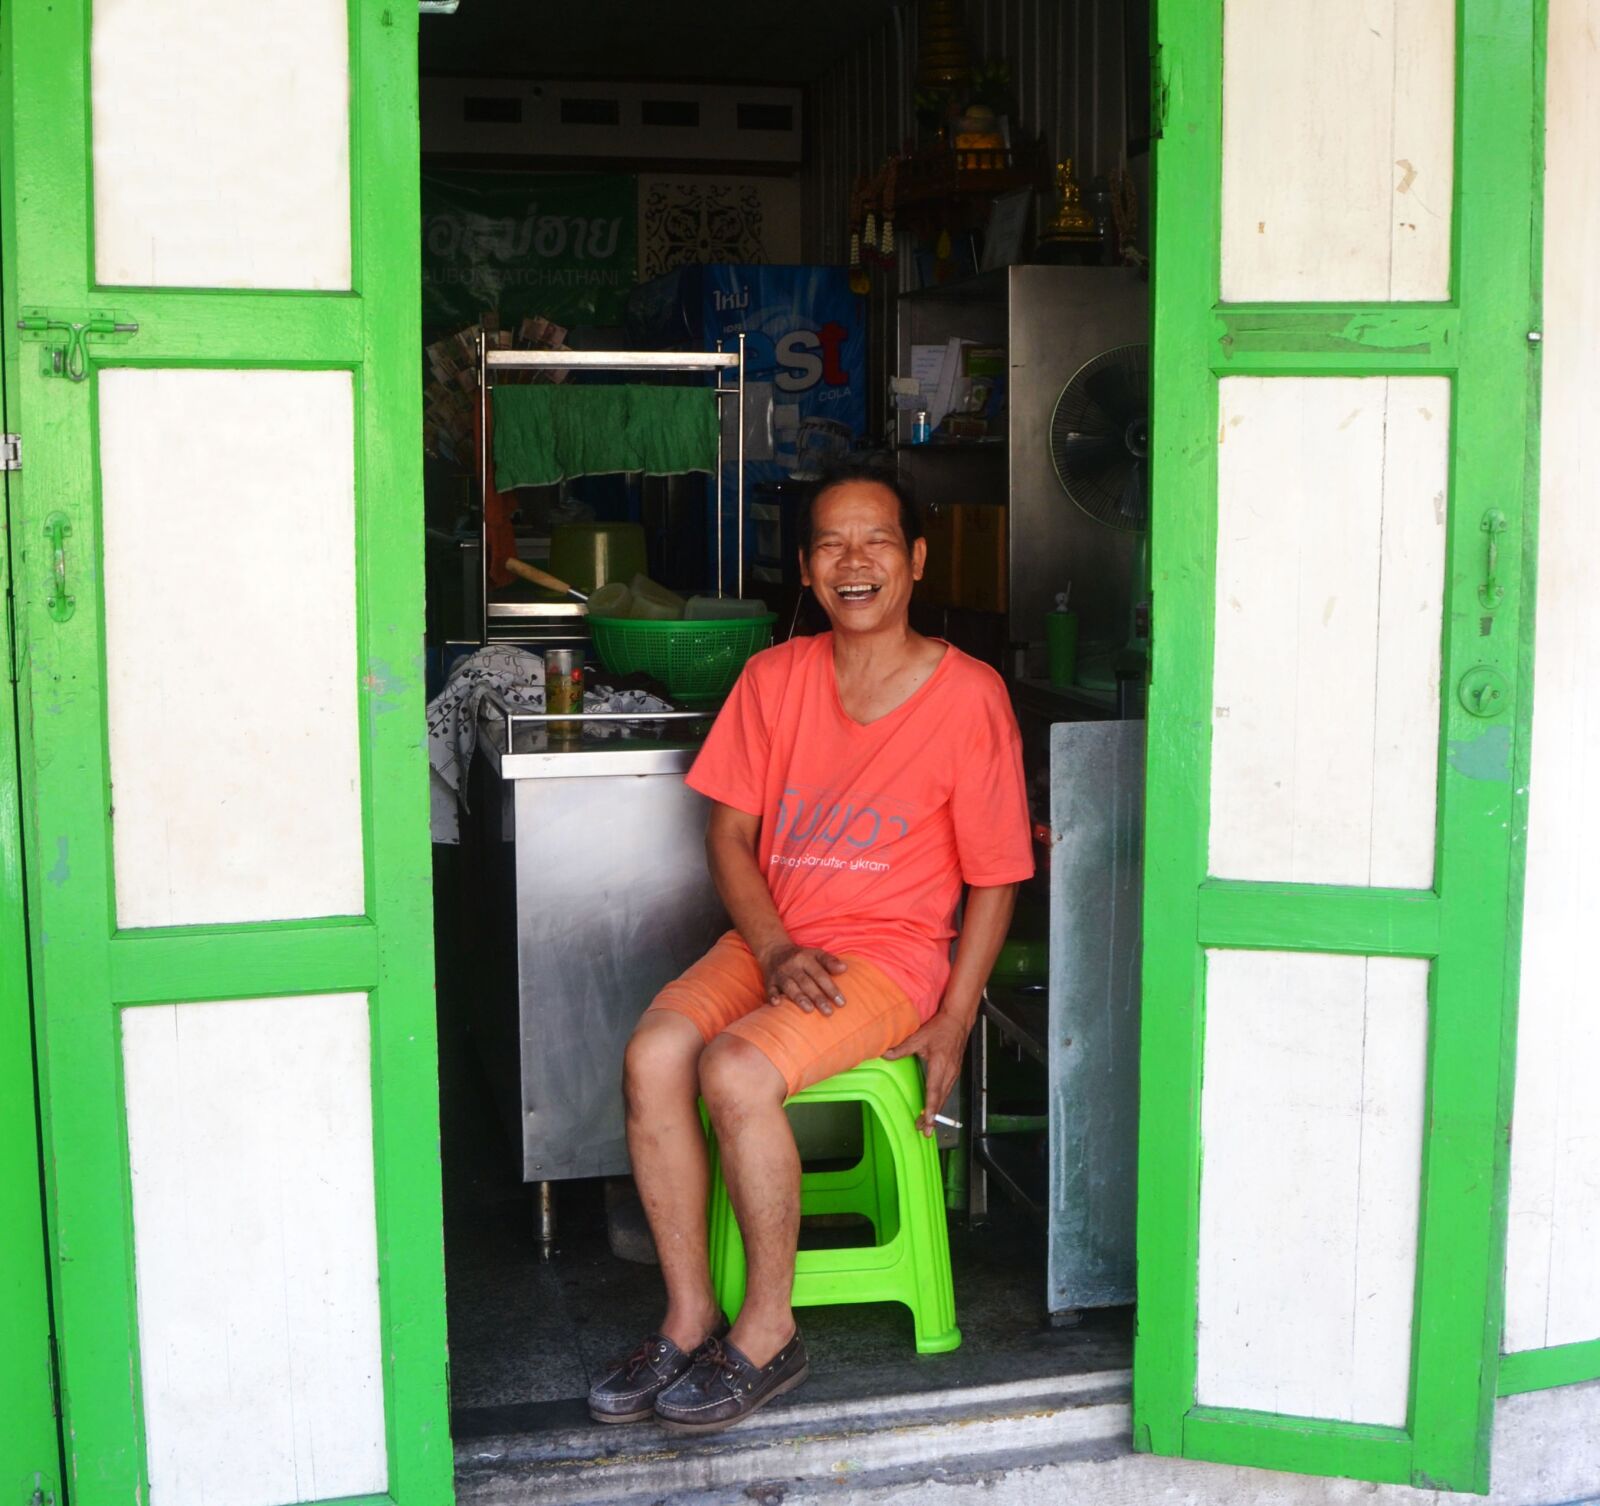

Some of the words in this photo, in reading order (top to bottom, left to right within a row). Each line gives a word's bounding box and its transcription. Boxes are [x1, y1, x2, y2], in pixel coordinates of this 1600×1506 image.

[713, 284, 749, 312] ใหม่
[722, 320, 850, 394] est
[818, 387, 852, 403] COLA
